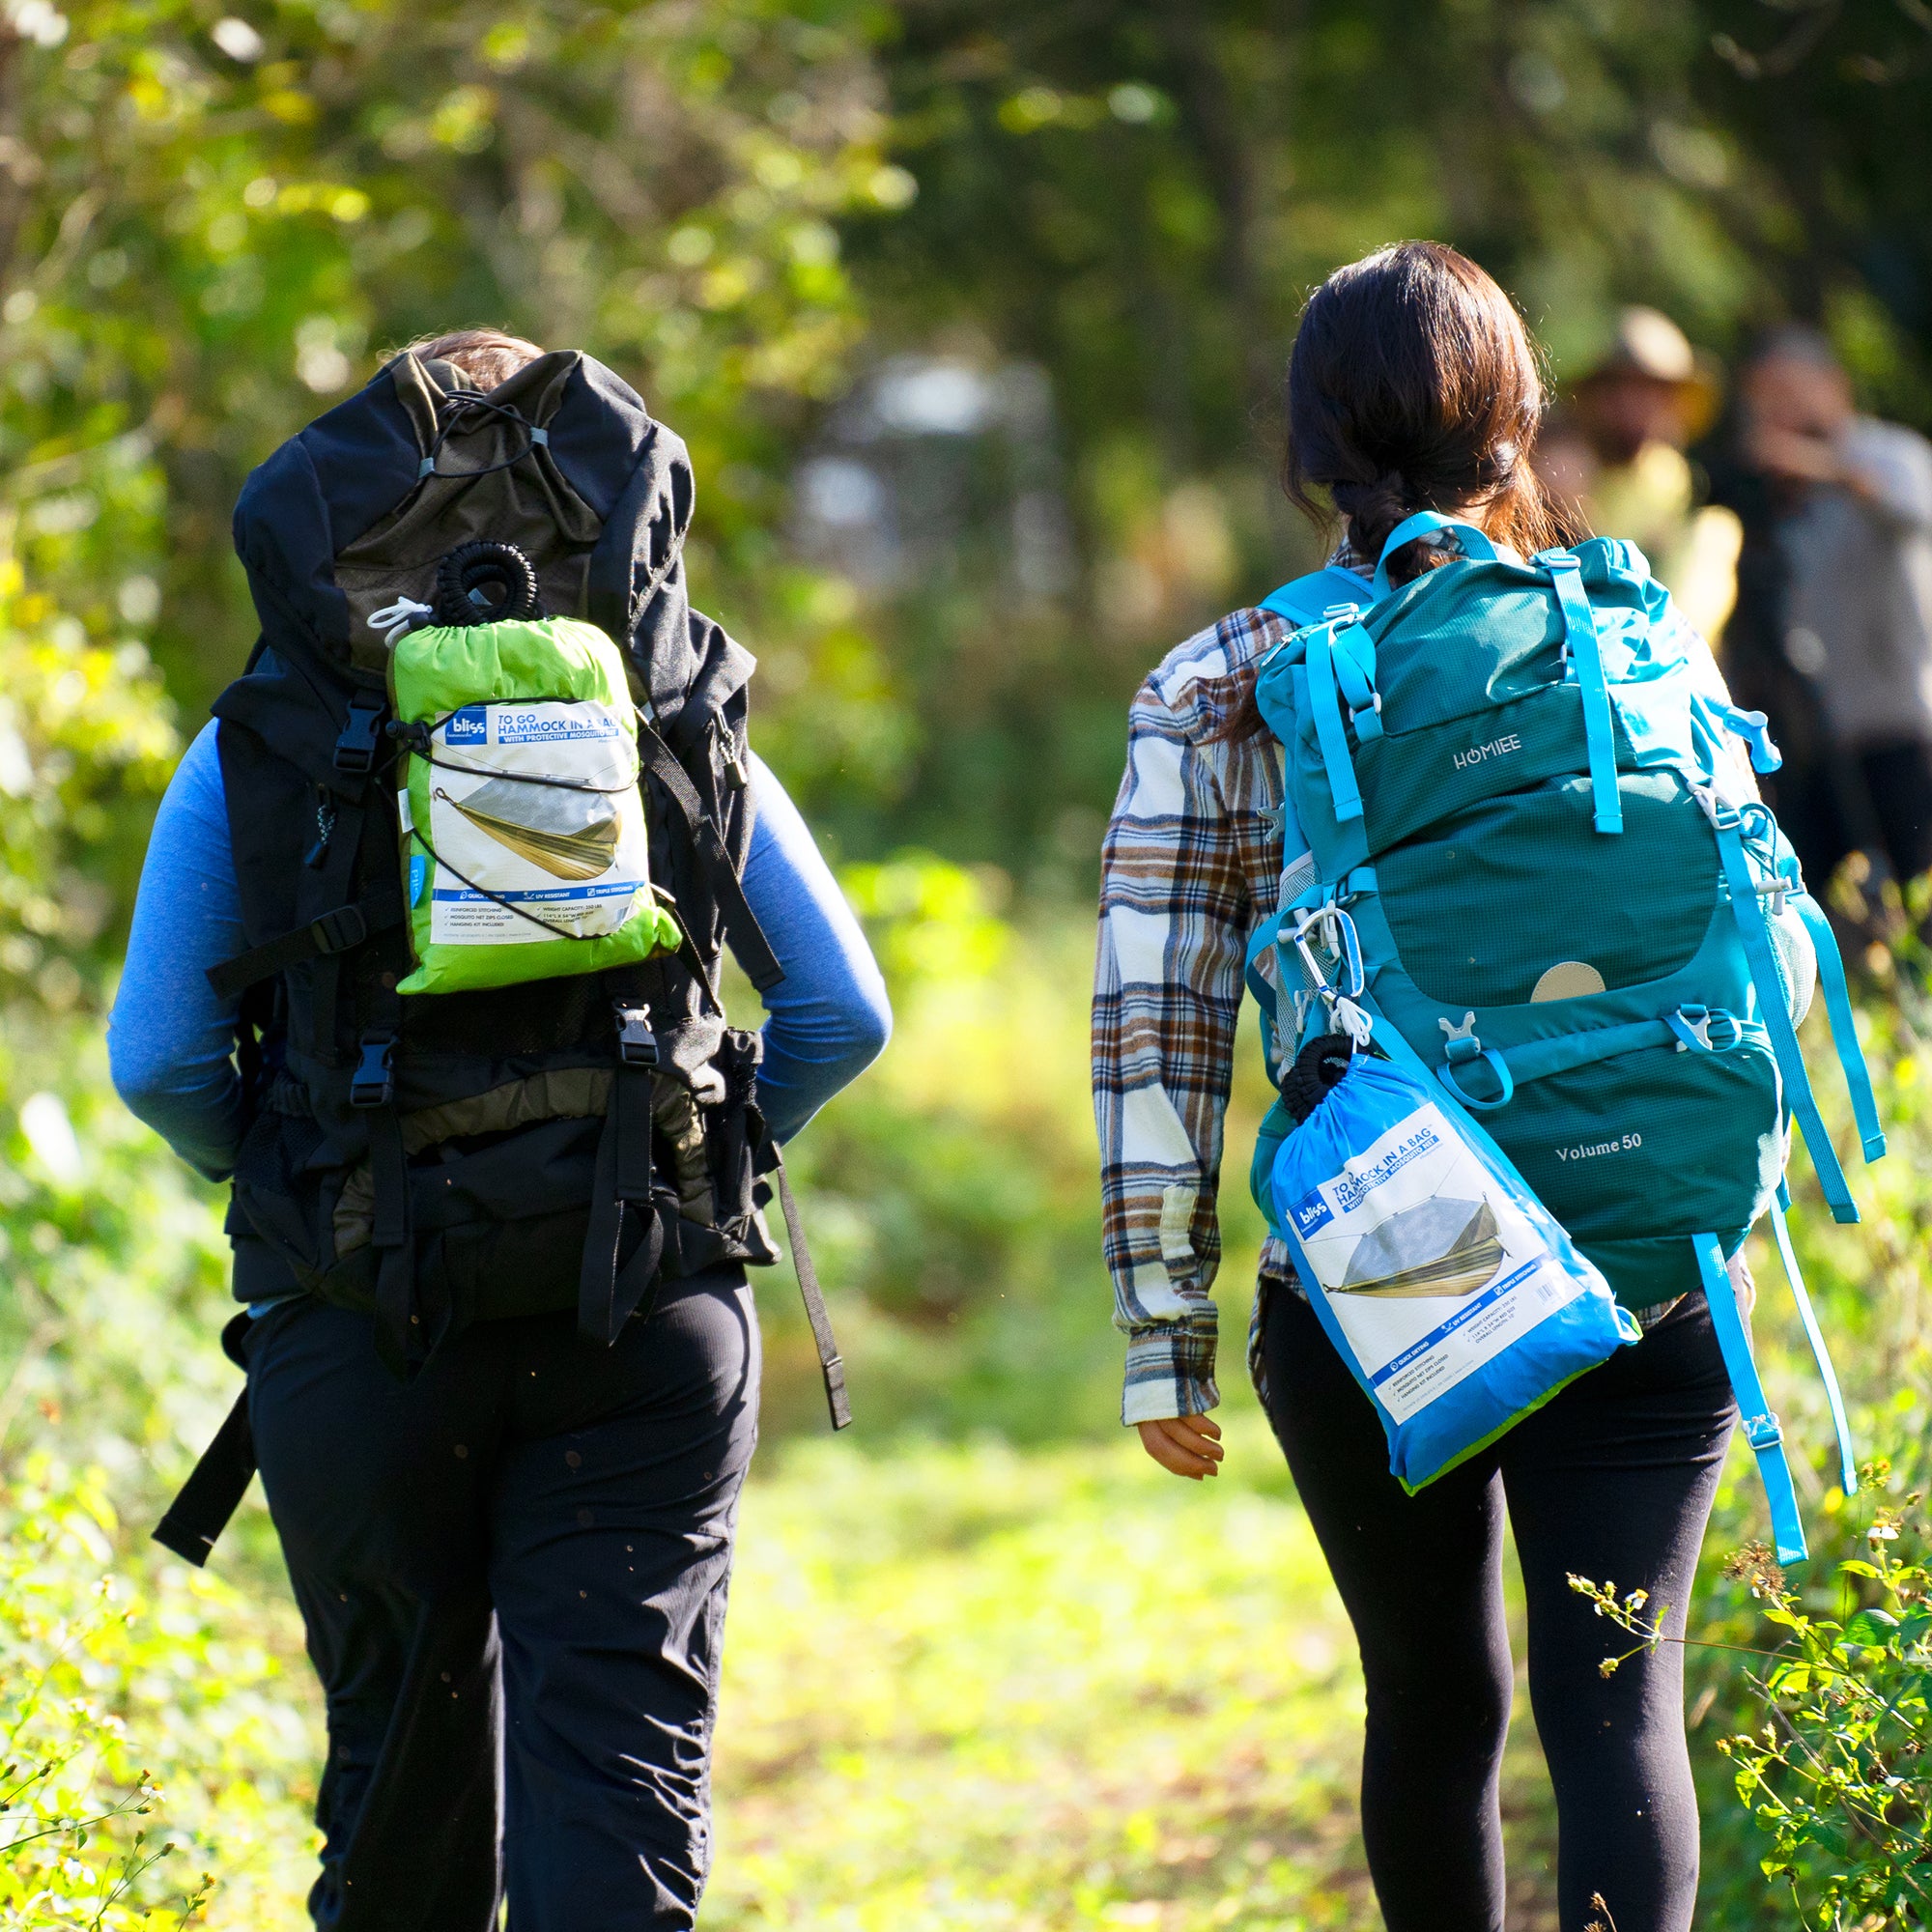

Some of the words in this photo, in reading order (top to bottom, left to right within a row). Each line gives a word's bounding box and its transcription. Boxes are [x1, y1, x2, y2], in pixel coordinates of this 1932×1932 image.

[453, 718, 486, 734] bliss
[498, 715, 513, 724] TO
[517, 714, 535, 724] GO
[498, 721, 567, 734] HAMMOCK
[570, 720, 583, 730] IN
[597, 718, 616, 728] AG
[526, 732, 568, 742] PROTECTIVE
[570, 729, 605, 739] MOSQUITO
[1453, 734, 1521, 770] HOMIEE
[1382, 1151, 1398, 1166] IN
[1399, 1145, 1408, 1154] A
[1407, 1127, 1431, 1147] BAG
[1555, 1141, 1620, 1162] Volume
[1622, 1133, 1642, 1150] 50
[1389, 1147, 1423, 1174] MOSQUITO
[1421, 1138, 1435, 1150] NET
[1332, 1182, 1349, 1196] TO
[1299, 1202, 1327, 1225] bliss
[1460, 1303, 1483, 1321] RESISTANT
[1398, 1353, 1413, 1366] QUICK
[1397, 1377, 1418, 1393] MOSQUITO
